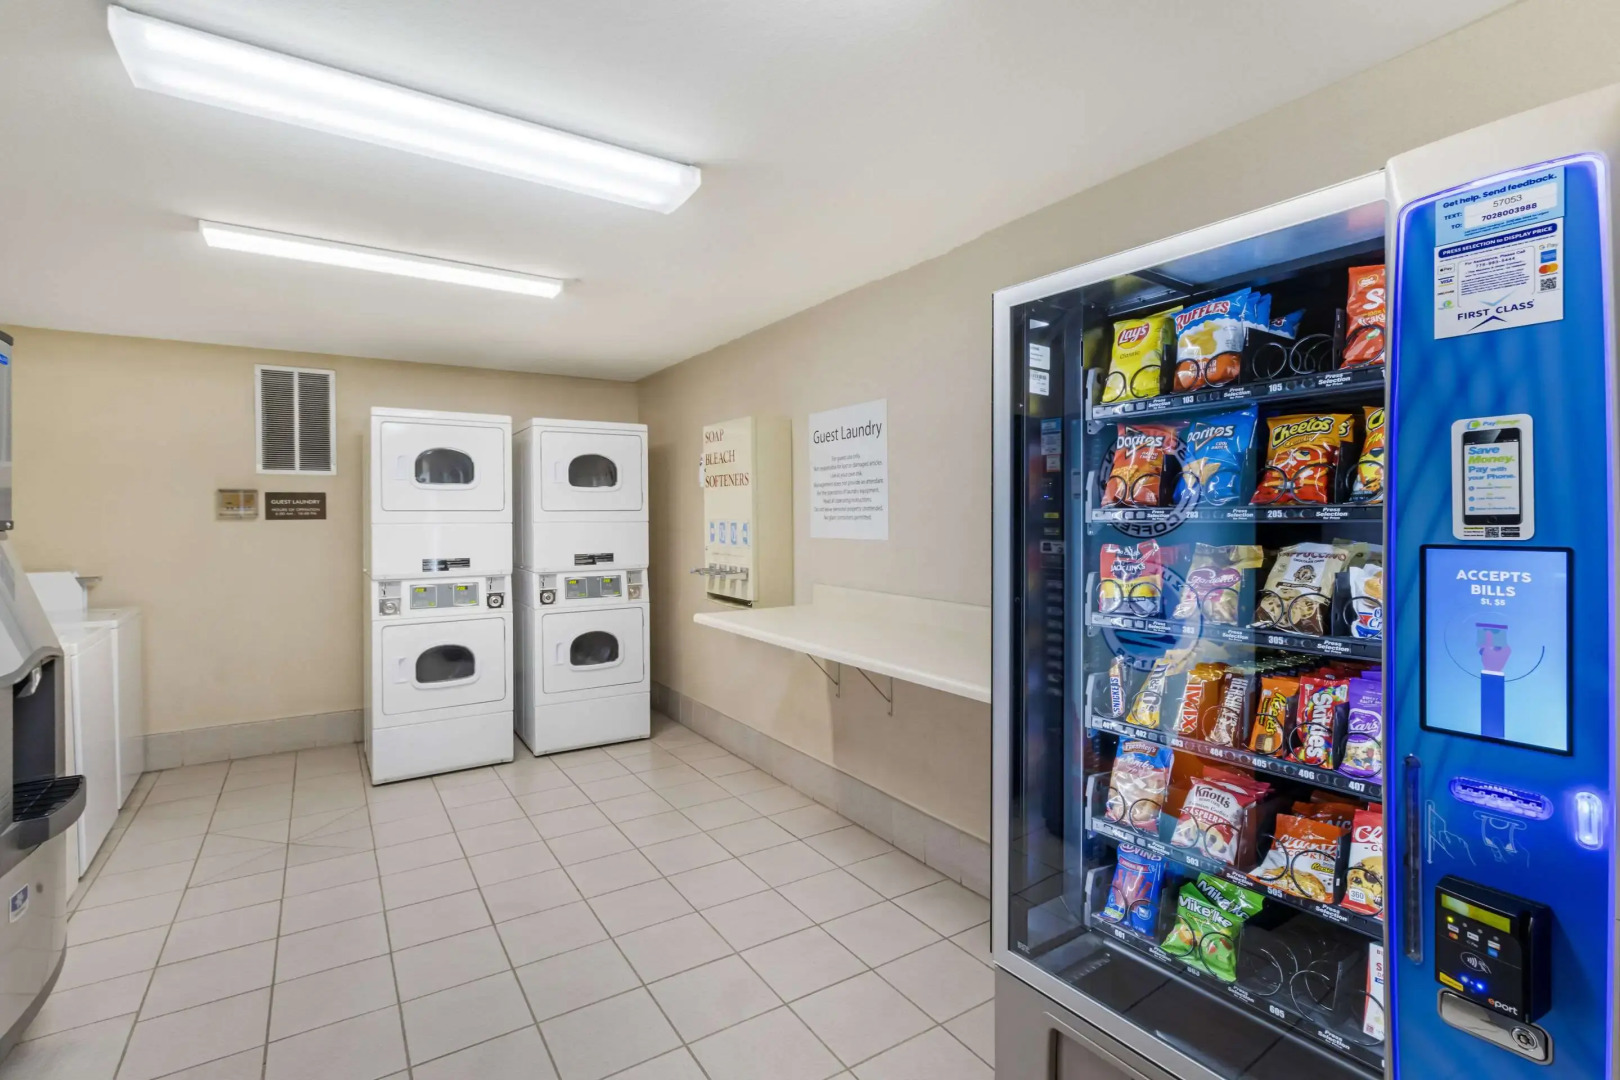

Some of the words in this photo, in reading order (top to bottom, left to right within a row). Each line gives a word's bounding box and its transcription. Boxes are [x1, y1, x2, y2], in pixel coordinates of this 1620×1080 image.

[1443, 198, 1461, 208] Get
[1460, 195, 1481, 204] help.
[1483, 187, 1506, 197] Send
[1508, 173, 1557, 191] feedback.
[1493, 194, 1523, 207] 57053
[1444, 212, 1462, 220] TEXT:
[1481, 203, 1537, 221] 7028003988
[1442, 247, 1461, 256] PRESS
[1462, 240, 1495, 252] SELECTION
[1503, 231, 1532, 242] DISPLAY
[1532, 226, 1553, 236] PRICE
[1176, 300, 1230, 331] RUFFLES
[1457, 308, 1490, 320] FIRST
[1495, 301, 1534, 314] CLASS
[1318, 376, 1350, 385] Selection
[1269, 383, 1282, 392] 105
[705, 428, 724, 444] SOAP
[813, 429, 838, 444] Guest
[841, 420, 882, 439] Laundry
[1272, 417, 1334, 449] Cheetos
[1117, 434, 1164, 449] Doritos
[705, 449, 735, 465] BLEACH
[1468, 447, 1500, 455] Save
[1468, 455, 1515, 465] Money.
[705, 473, 749, 488] SOFTENERS
[1268, 510, 1282, 518] 205
[1456, 569, 1532, 583] ACCEPTS
[1471, 584, 1516, 597] BILLS
[1494, 598, 1506, 606] $5
[1268, 636, 1283, 644] 305
[1317, 643, 1350, 652] Selection
[1182, 684, 1203, 731] TWIX
[1306, 692, 1333, 758] Skittles
[1136, 729, 1146, 738] 402
[1252, 759, 1267, 768] 405
[1298, 769, 1315, 780] 406
[1349, 781, 1365, 792] 407
[1195, 785, 1231, 808] Knott's
[1267, 887, 1282, 898] 505
[1350, 890, 1364, 900] 360
[1316, 906, 1348, 921] Selection
[1322, 904, 1340, 914] Press
[1269, 1005, 1285, 1018] 605
